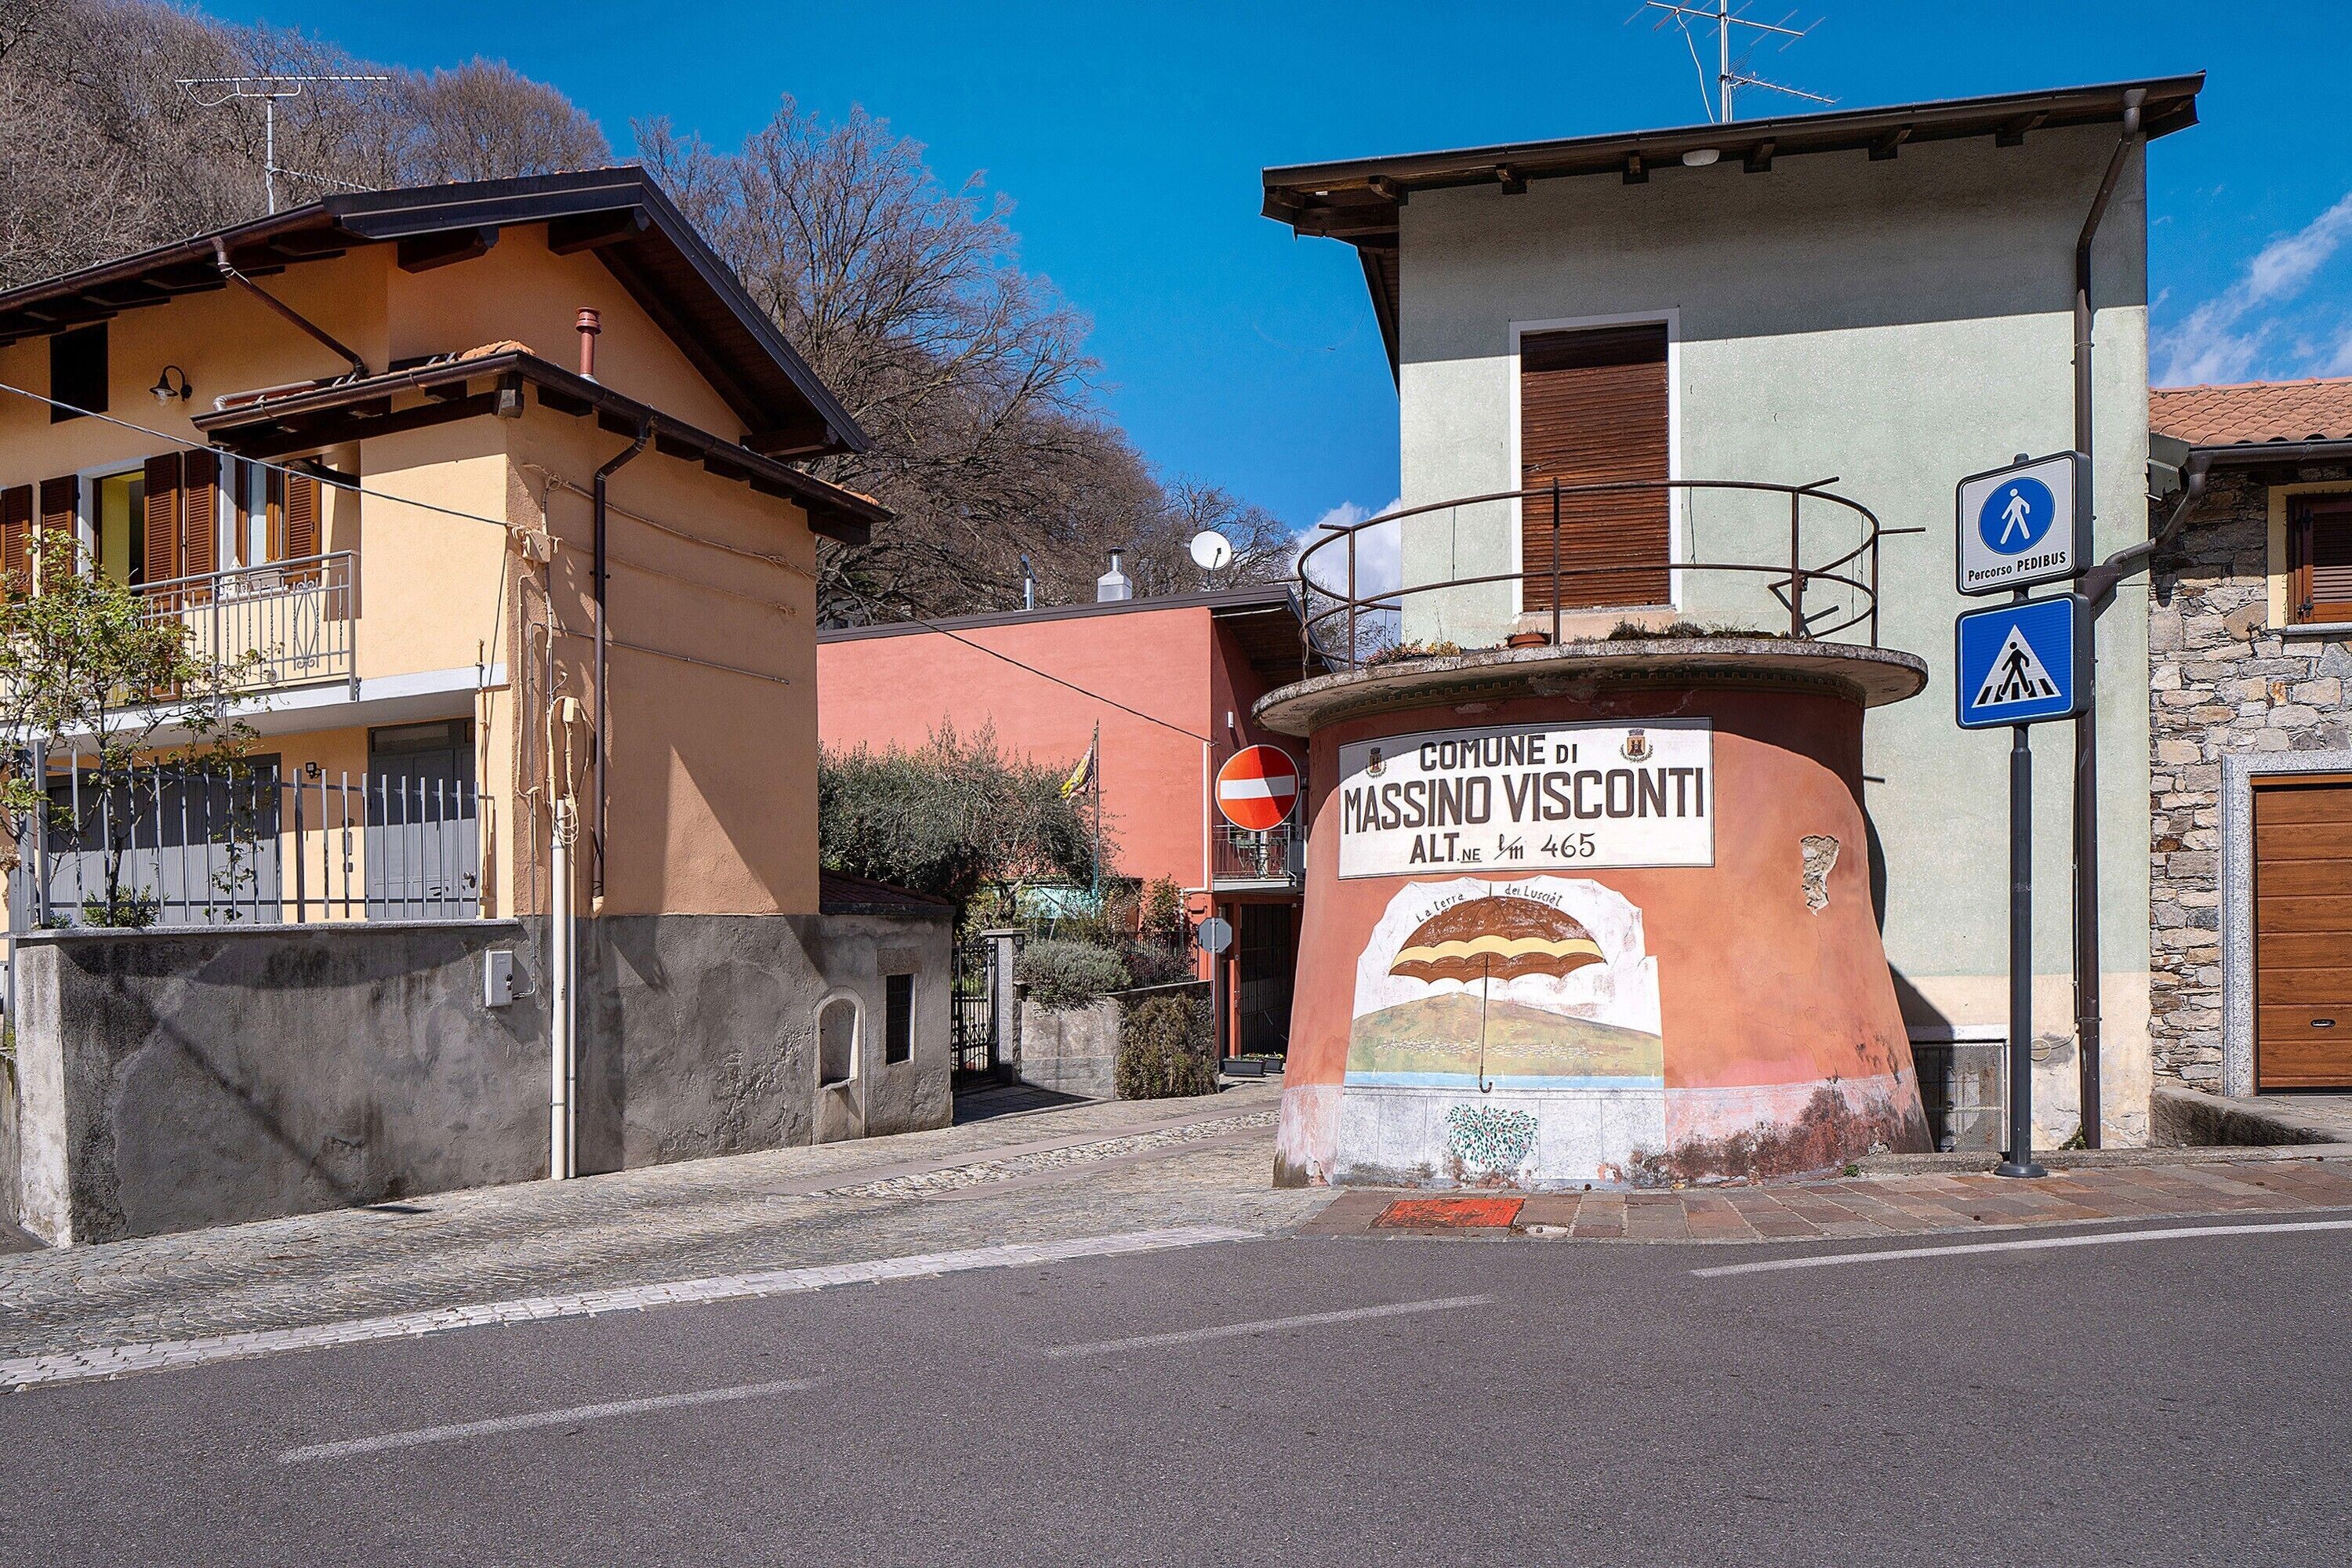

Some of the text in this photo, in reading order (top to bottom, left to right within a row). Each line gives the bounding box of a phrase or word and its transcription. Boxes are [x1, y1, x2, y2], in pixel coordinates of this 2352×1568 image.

[1968, 551, 2067, 582] Percorso PEDIBUS
[1419, 734, 1578, 772] COMUNE DI
[1344, 767, 1704, 835] MASSINO VISCONTI
[1540, 832, 1596, 858] 465
[1415, 909, 1432, 923] La
[1434, 894, 1465, 911] terra
